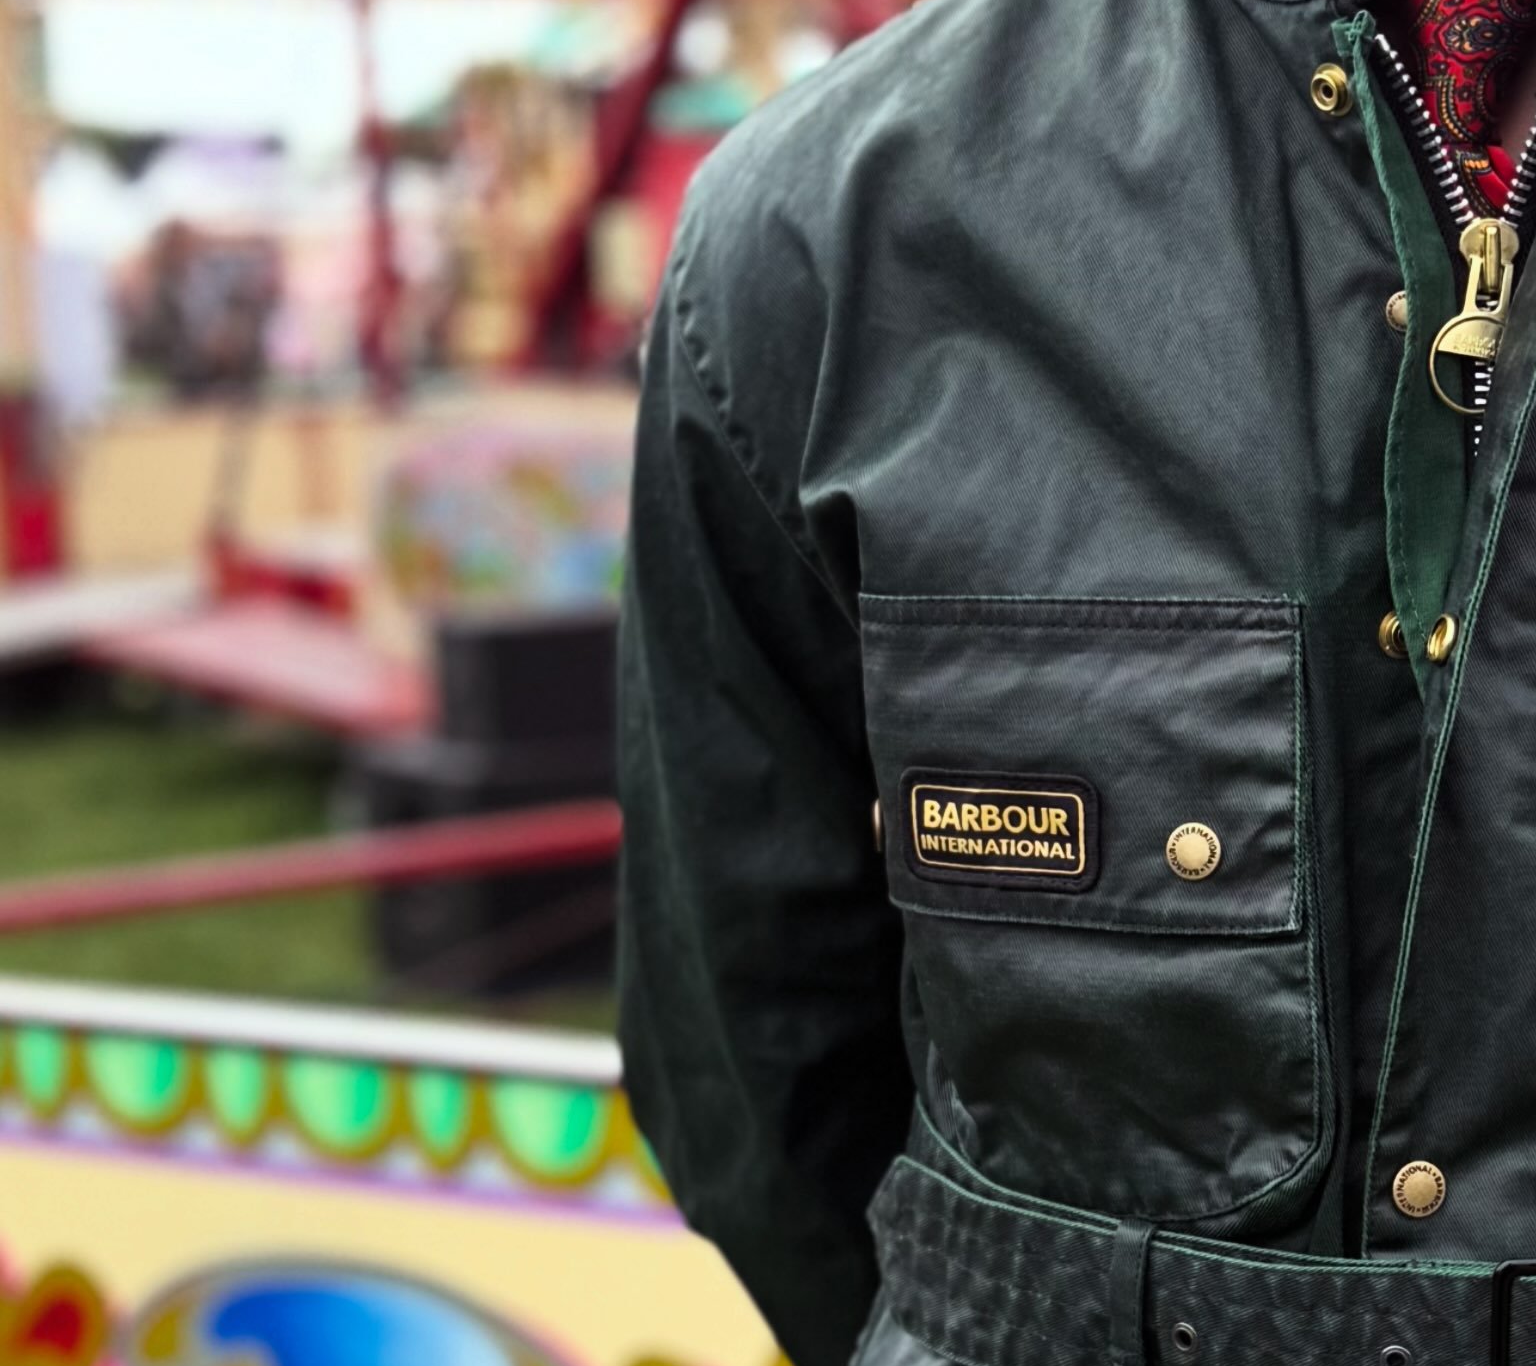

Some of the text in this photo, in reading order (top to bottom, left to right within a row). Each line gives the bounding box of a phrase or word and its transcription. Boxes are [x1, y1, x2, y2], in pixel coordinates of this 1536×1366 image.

[923, 800, 1070, 835] BARBOUR
[921, 834, 1076, 861] INTERNATIONAL
[1174, 826, 1217, 870] INTERNATIONAL
[1396, 1164, 1433, 1214] INTERNATIONAL
